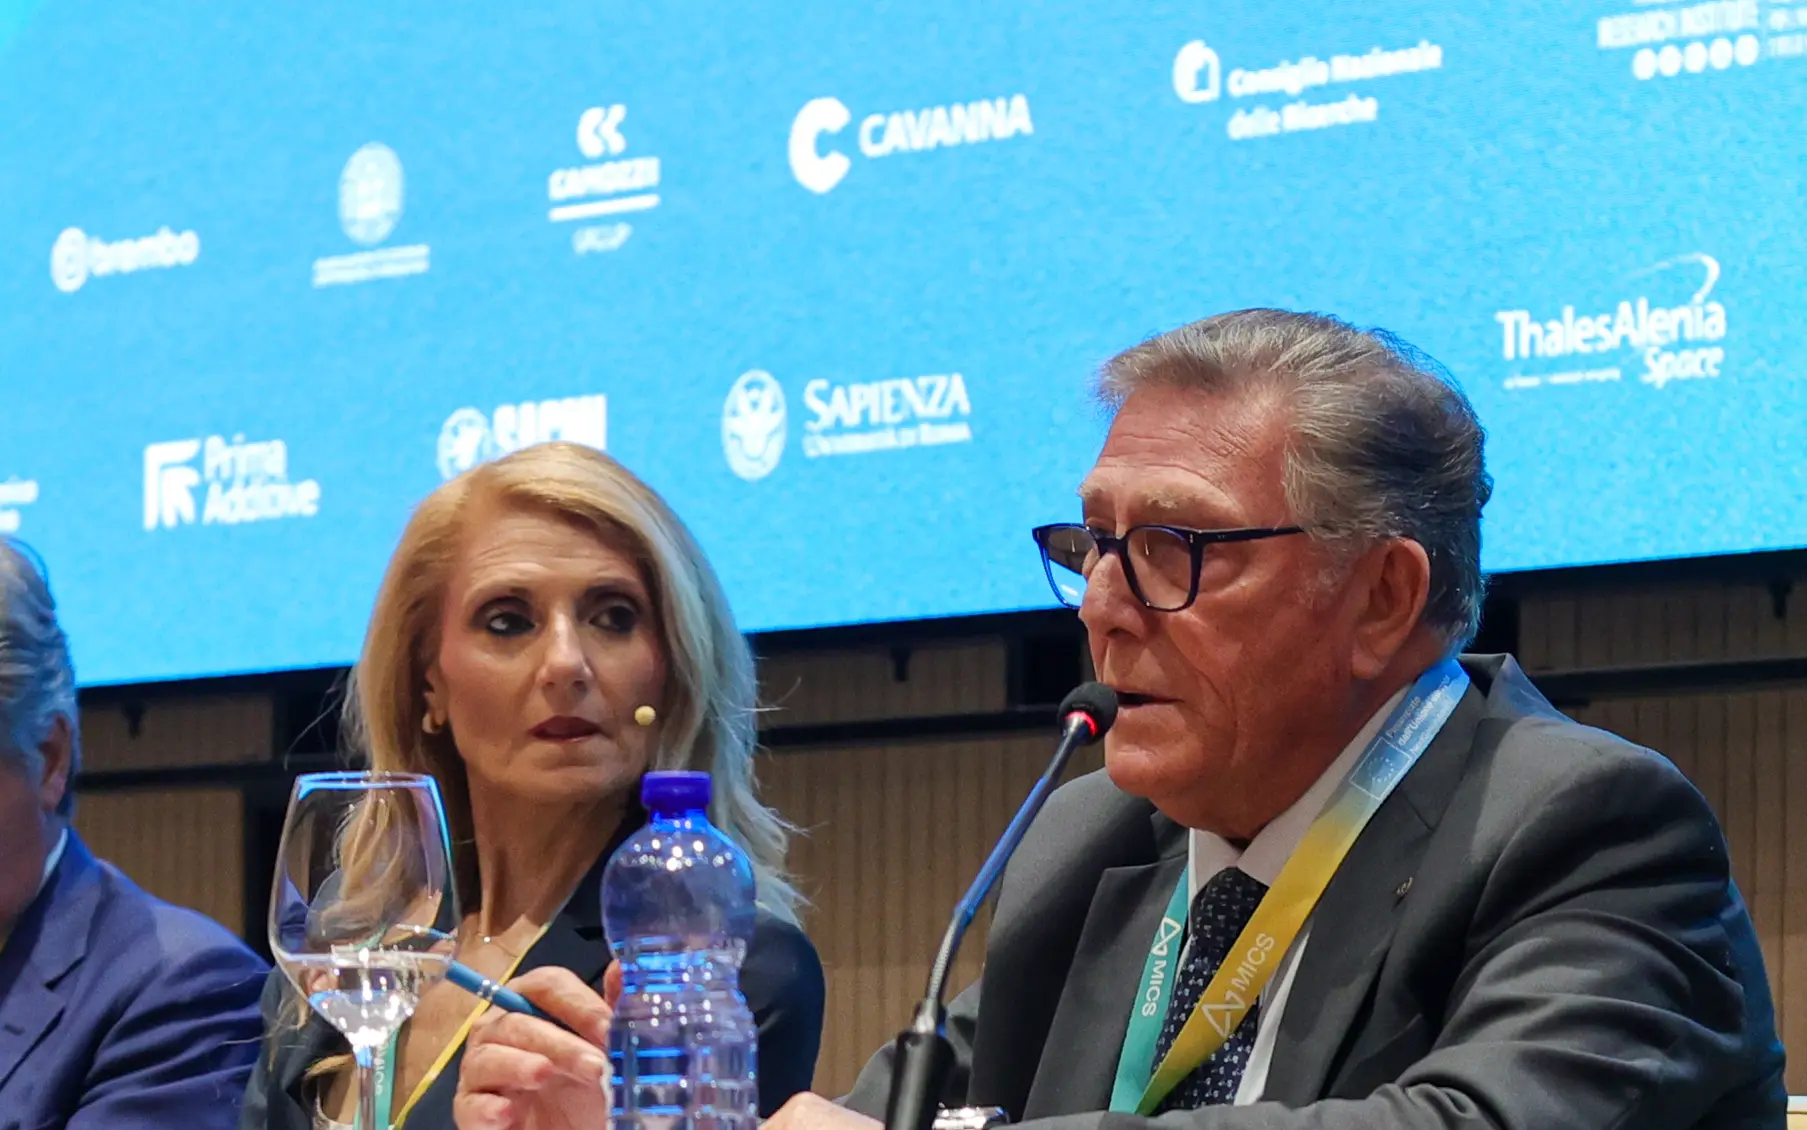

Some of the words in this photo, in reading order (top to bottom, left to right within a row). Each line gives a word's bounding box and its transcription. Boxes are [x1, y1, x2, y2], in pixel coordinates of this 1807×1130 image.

[858, 93, 1034, 158] CAVANNA
[1640, 346, 1725, 389] Space
[803, 373, 971, 432] SAPIENZA
[1141, 960, 1167, 1017] MICS
[1230, 933, 1275, 991] MICS
